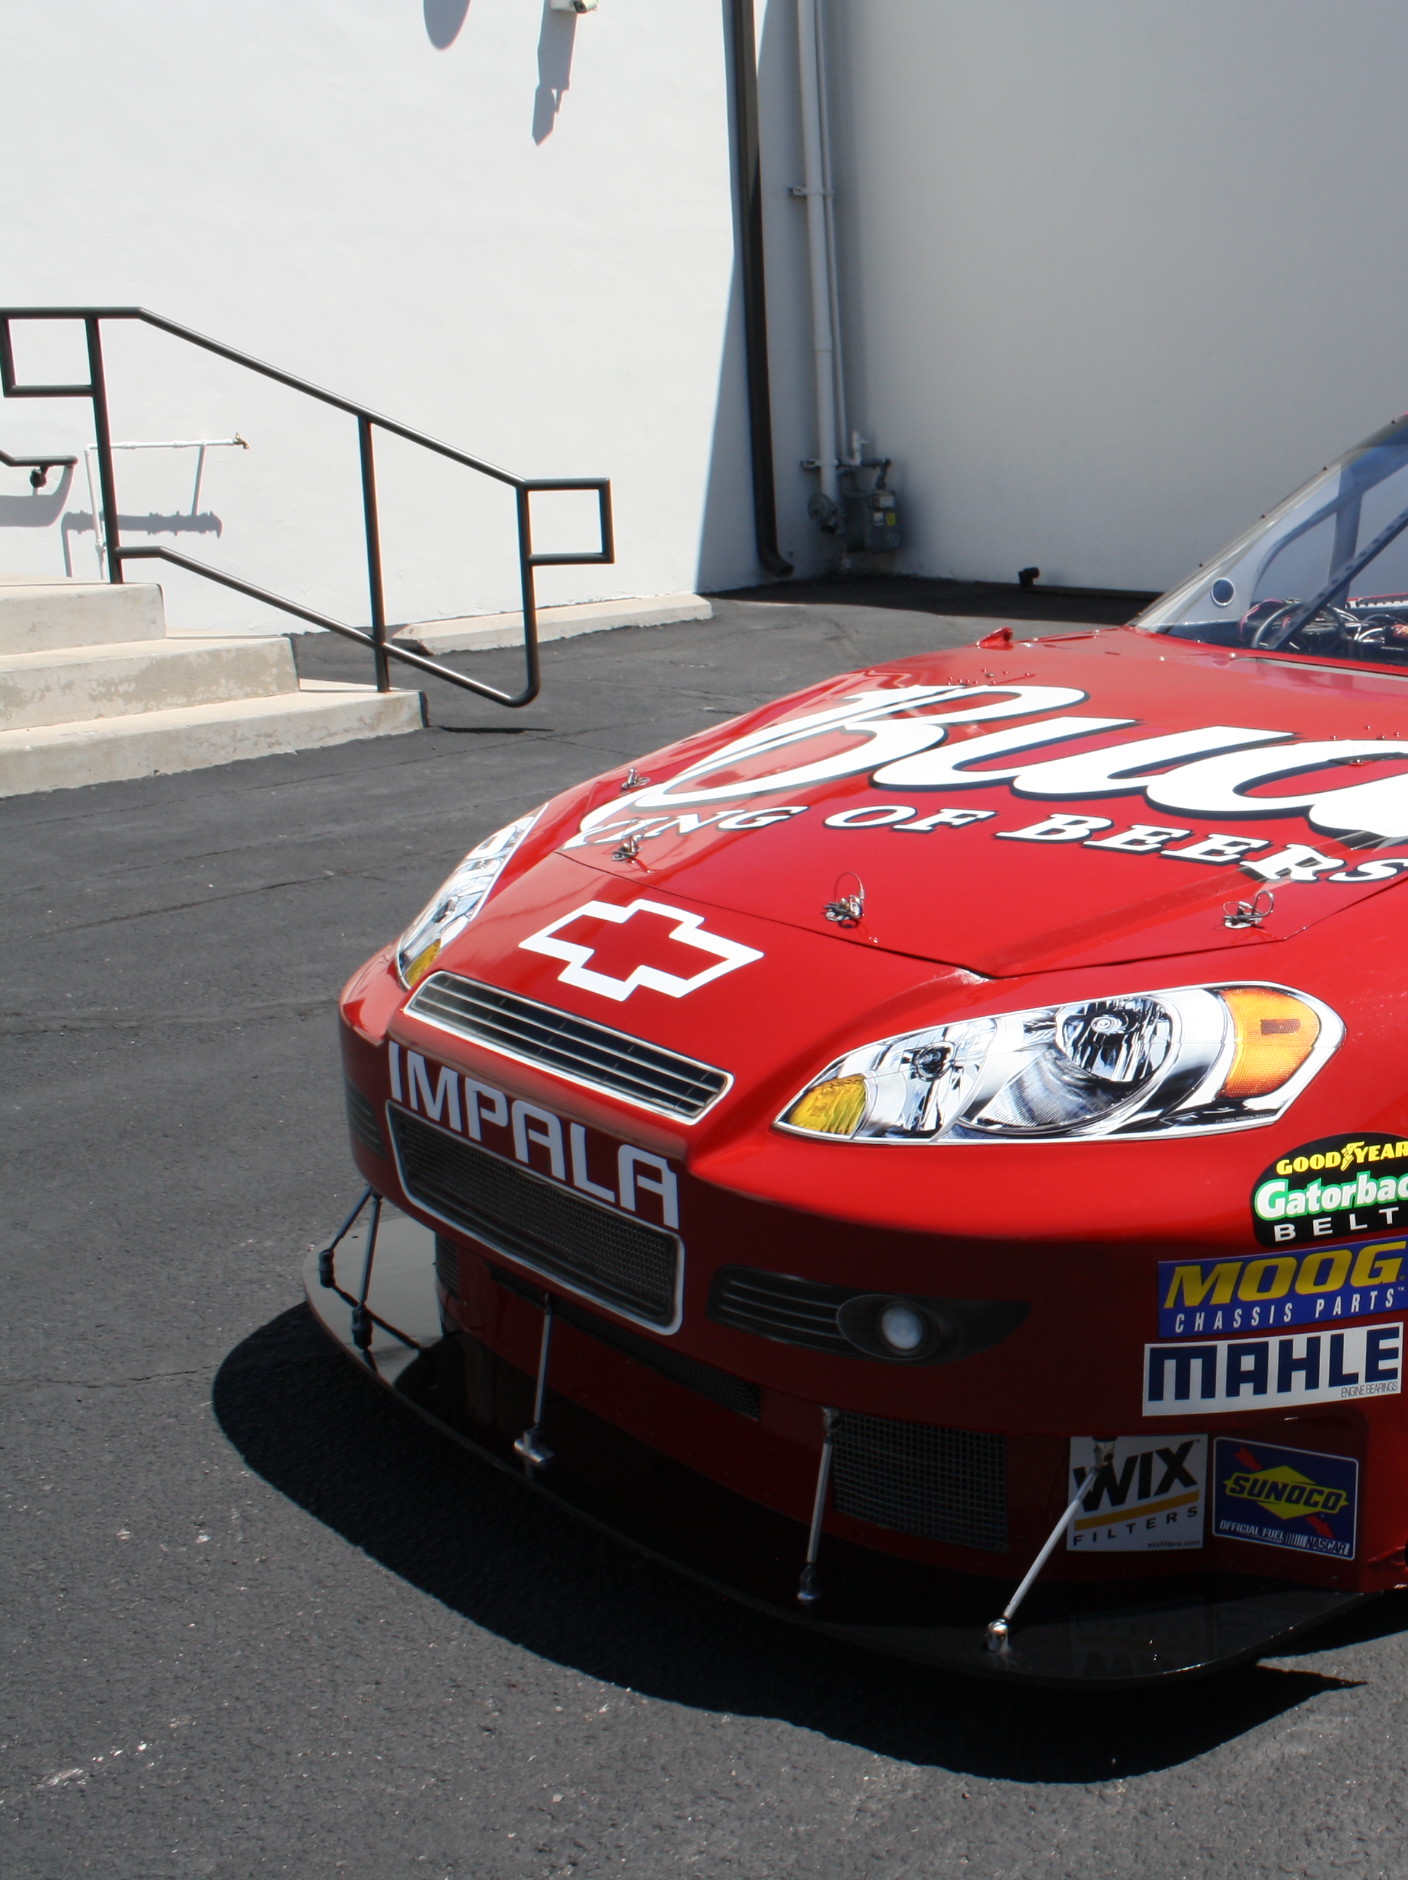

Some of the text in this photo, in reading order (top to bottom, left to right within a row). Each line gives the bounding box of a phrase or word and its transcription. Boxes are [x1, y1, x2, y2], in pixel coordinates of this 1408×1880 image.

[823, 804, 1000, 833] OF
[388, 1040, 680, 1230] IMPALA
[1163, 1240, 1408, 1309] MOOG
[1175, 1287, 1396, 1334] CHASSIS PARTS
[1148, 1326, 1400, 1402] MAHLE
[1340, 1381, 1398, 1398] ENGINE BEARINGS
[1072, 1439, 1198, 1513] WIX
[1228, 1475, 1346, 1512] SUNOCO
[1073, 1506, 1199, 1547] FILTERS
[1219, 1519, 1348, 1555] OFFICIAL FUEL NASCAR
